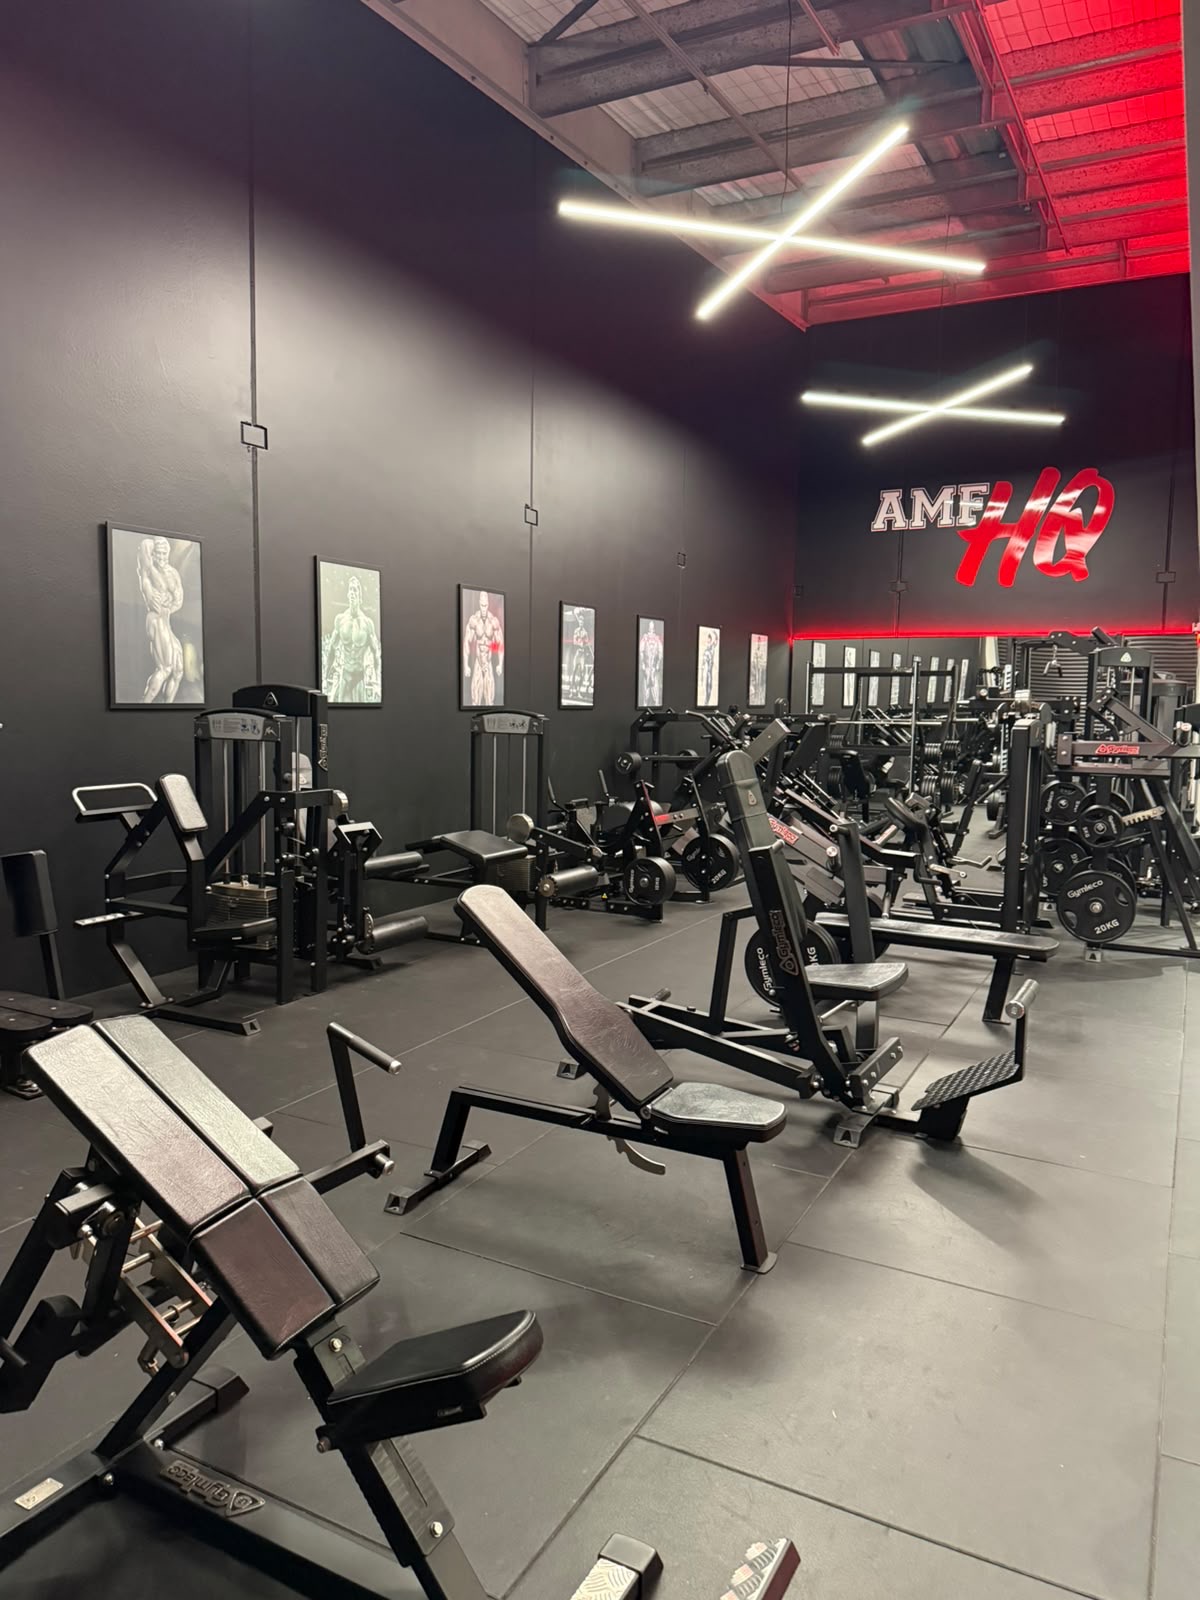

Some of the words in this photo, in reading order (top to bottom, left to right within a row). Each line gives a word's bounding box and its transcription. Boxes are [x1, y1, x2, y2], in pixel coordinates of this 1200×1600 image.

[871, 482, 990, 532] AMF
[955, 466, 1115, 588] HQ
[1066, 880, 1104, 898] Gymleco
[1094, 918, 1120, 934] 20KG
[806, 946, 819, 967] KG
[756, 947, 773, 991] Gymleco
